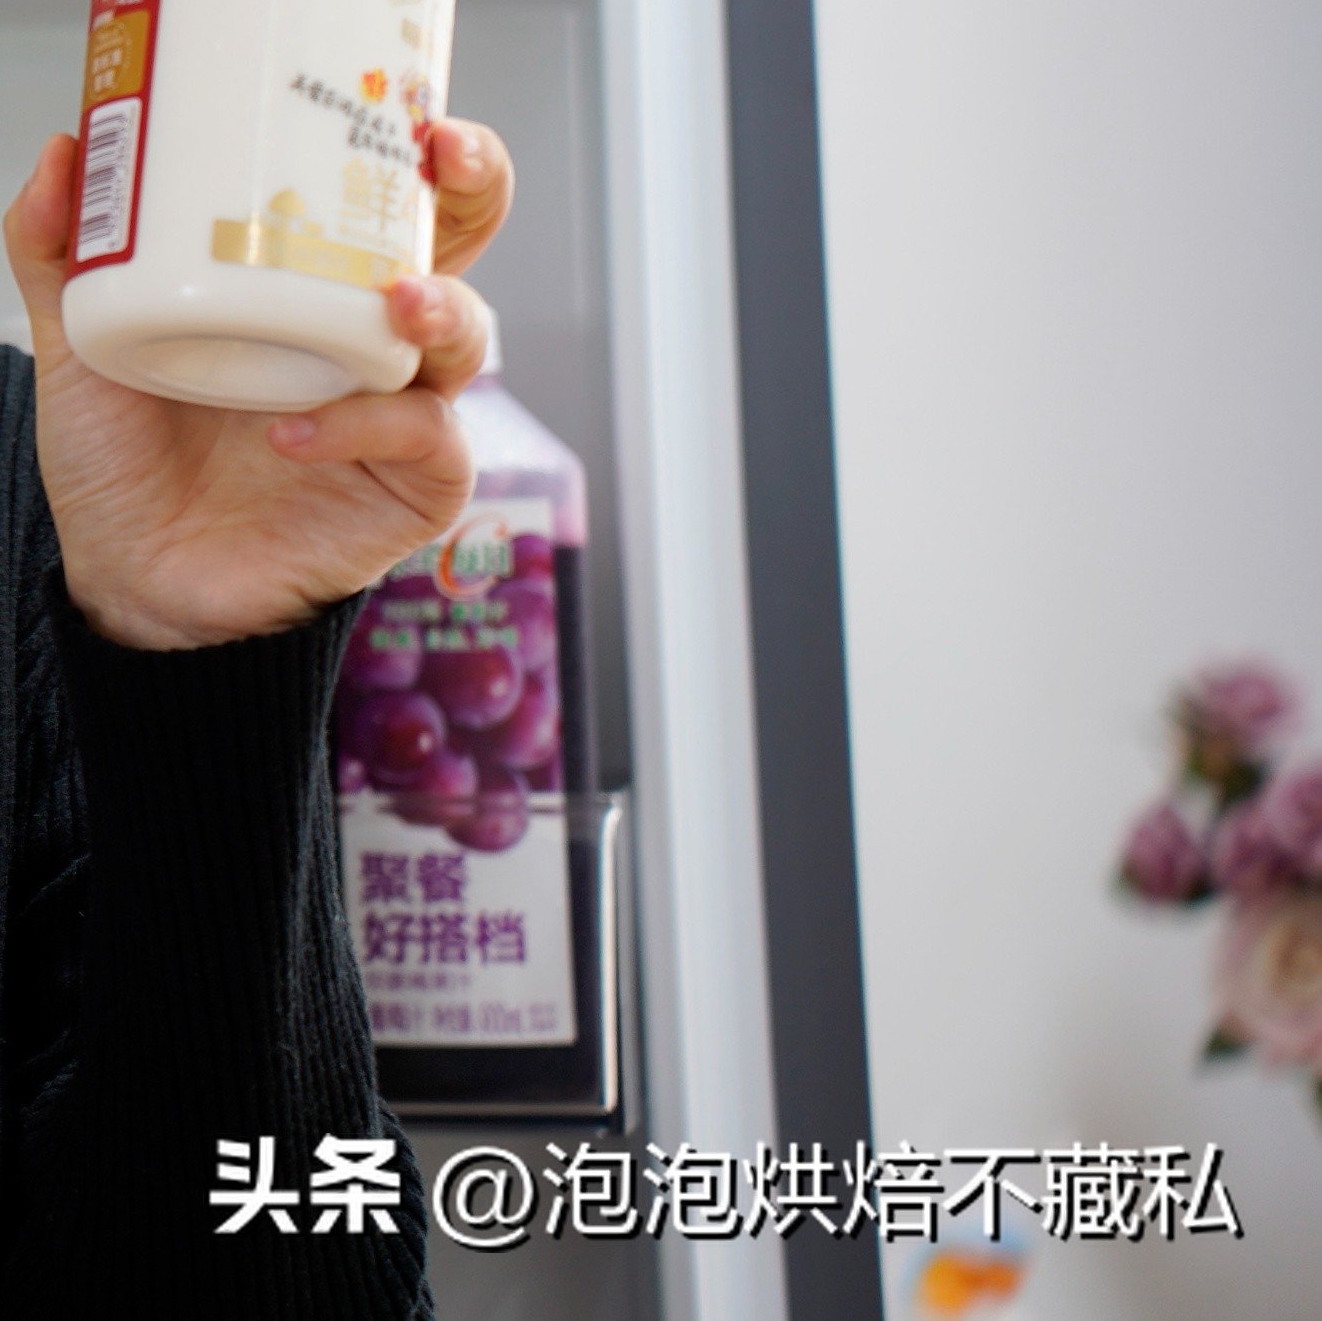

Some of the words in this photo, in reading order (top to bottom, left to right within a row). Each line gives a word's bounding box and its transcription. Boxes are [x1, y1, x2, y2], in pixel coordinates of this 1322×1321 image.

[361, 852, 465, 904] 聚餐
[363, 909, 525, 966] 好搭档
